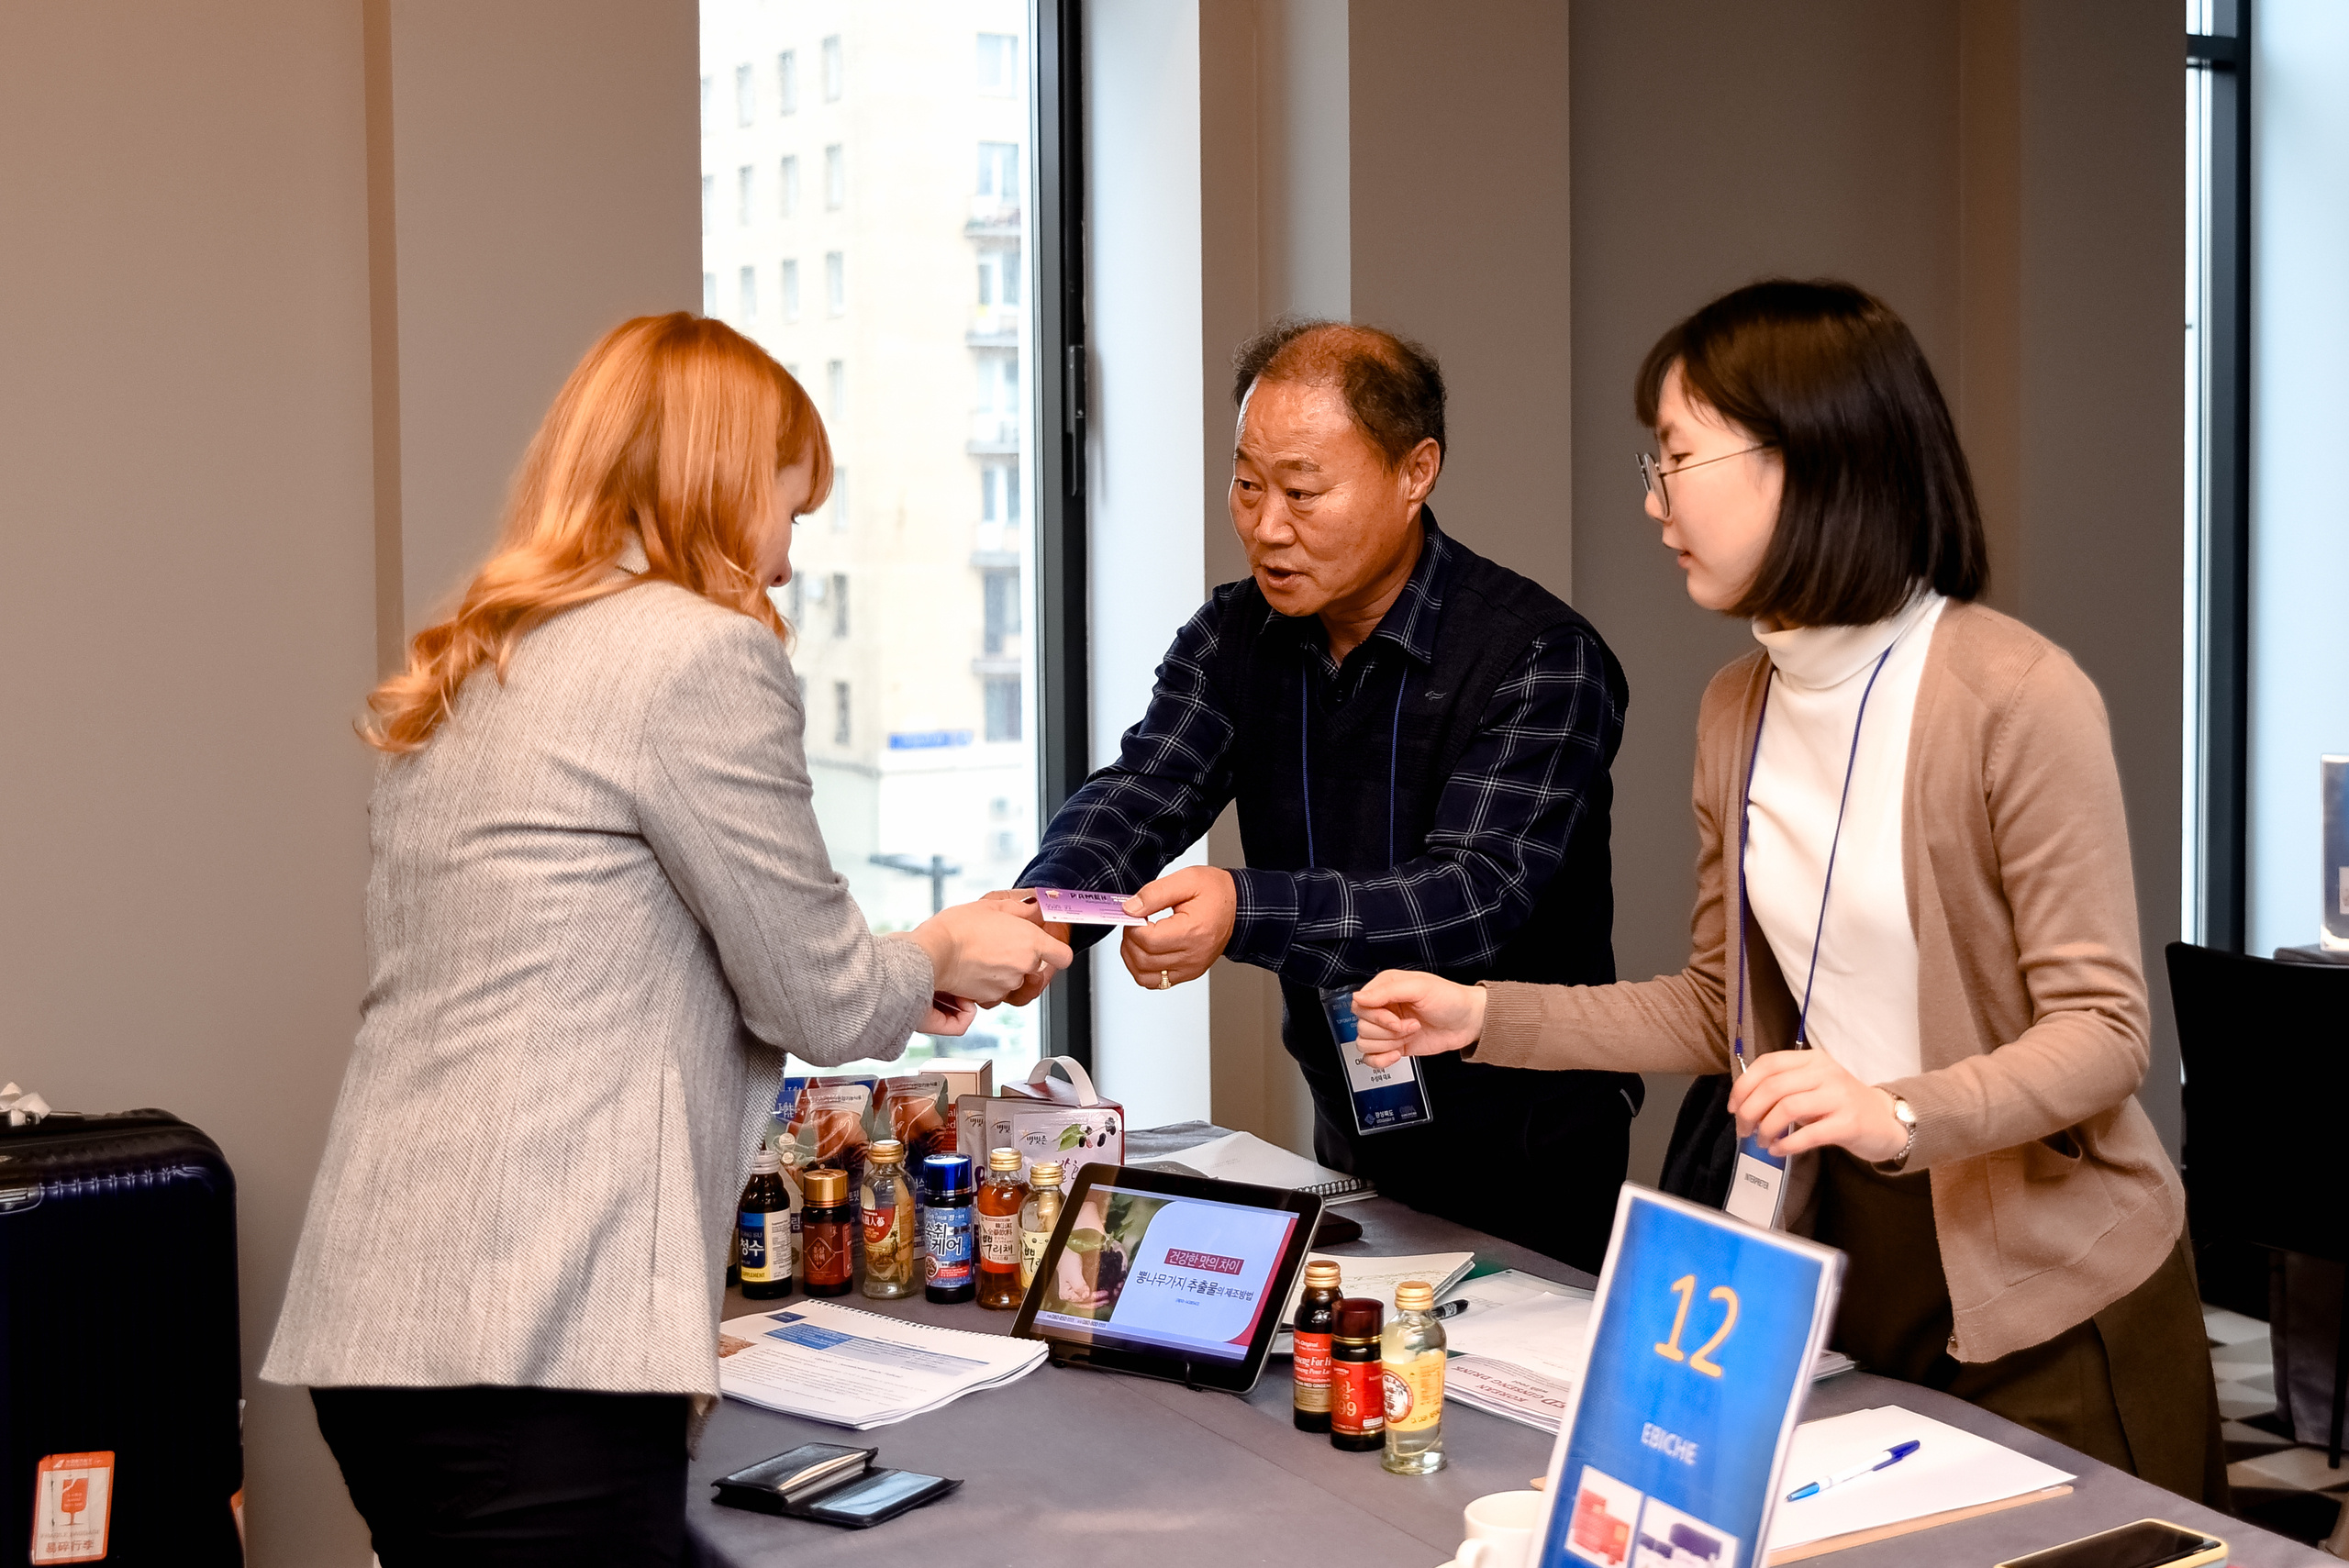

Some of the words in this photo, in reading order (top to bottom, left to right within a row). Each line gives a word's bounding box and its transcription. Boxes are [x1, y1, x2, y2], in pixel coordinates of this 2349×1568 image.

[924, 1221, 948, 1240] 숙취
[930, 1236, 962, 1256] 케어
[982, 1234, 1013, 1260] 뿌리채
[1169, 1250, 1198, 1267] 건강한
[1199, 1254, 1219, 1271] 맛의
[1219, 1258, 1241, 1273] 차이
[1136, 1270, 1186, 1291] 뽕나무가지
[1187, 1279, 1224, 1297] 추출물의
[1224, 1288, 1254, 1302] 제조방법
[1653, 1273, 1740, 1378] 12
[1300, 1340, 1319, 1348] Original
[1311, 1357, 1324, 1366] For
[1451, 1366, 1492, 1381] DRINK
[1475, 1384, 1529, 1403] KOREAN
[1491, 1379, 1544, 1400] GINSENG
[1641, 1421, 1699, 1466] EBICHE
[46, 1540, 94, 1553] 易碎行李
